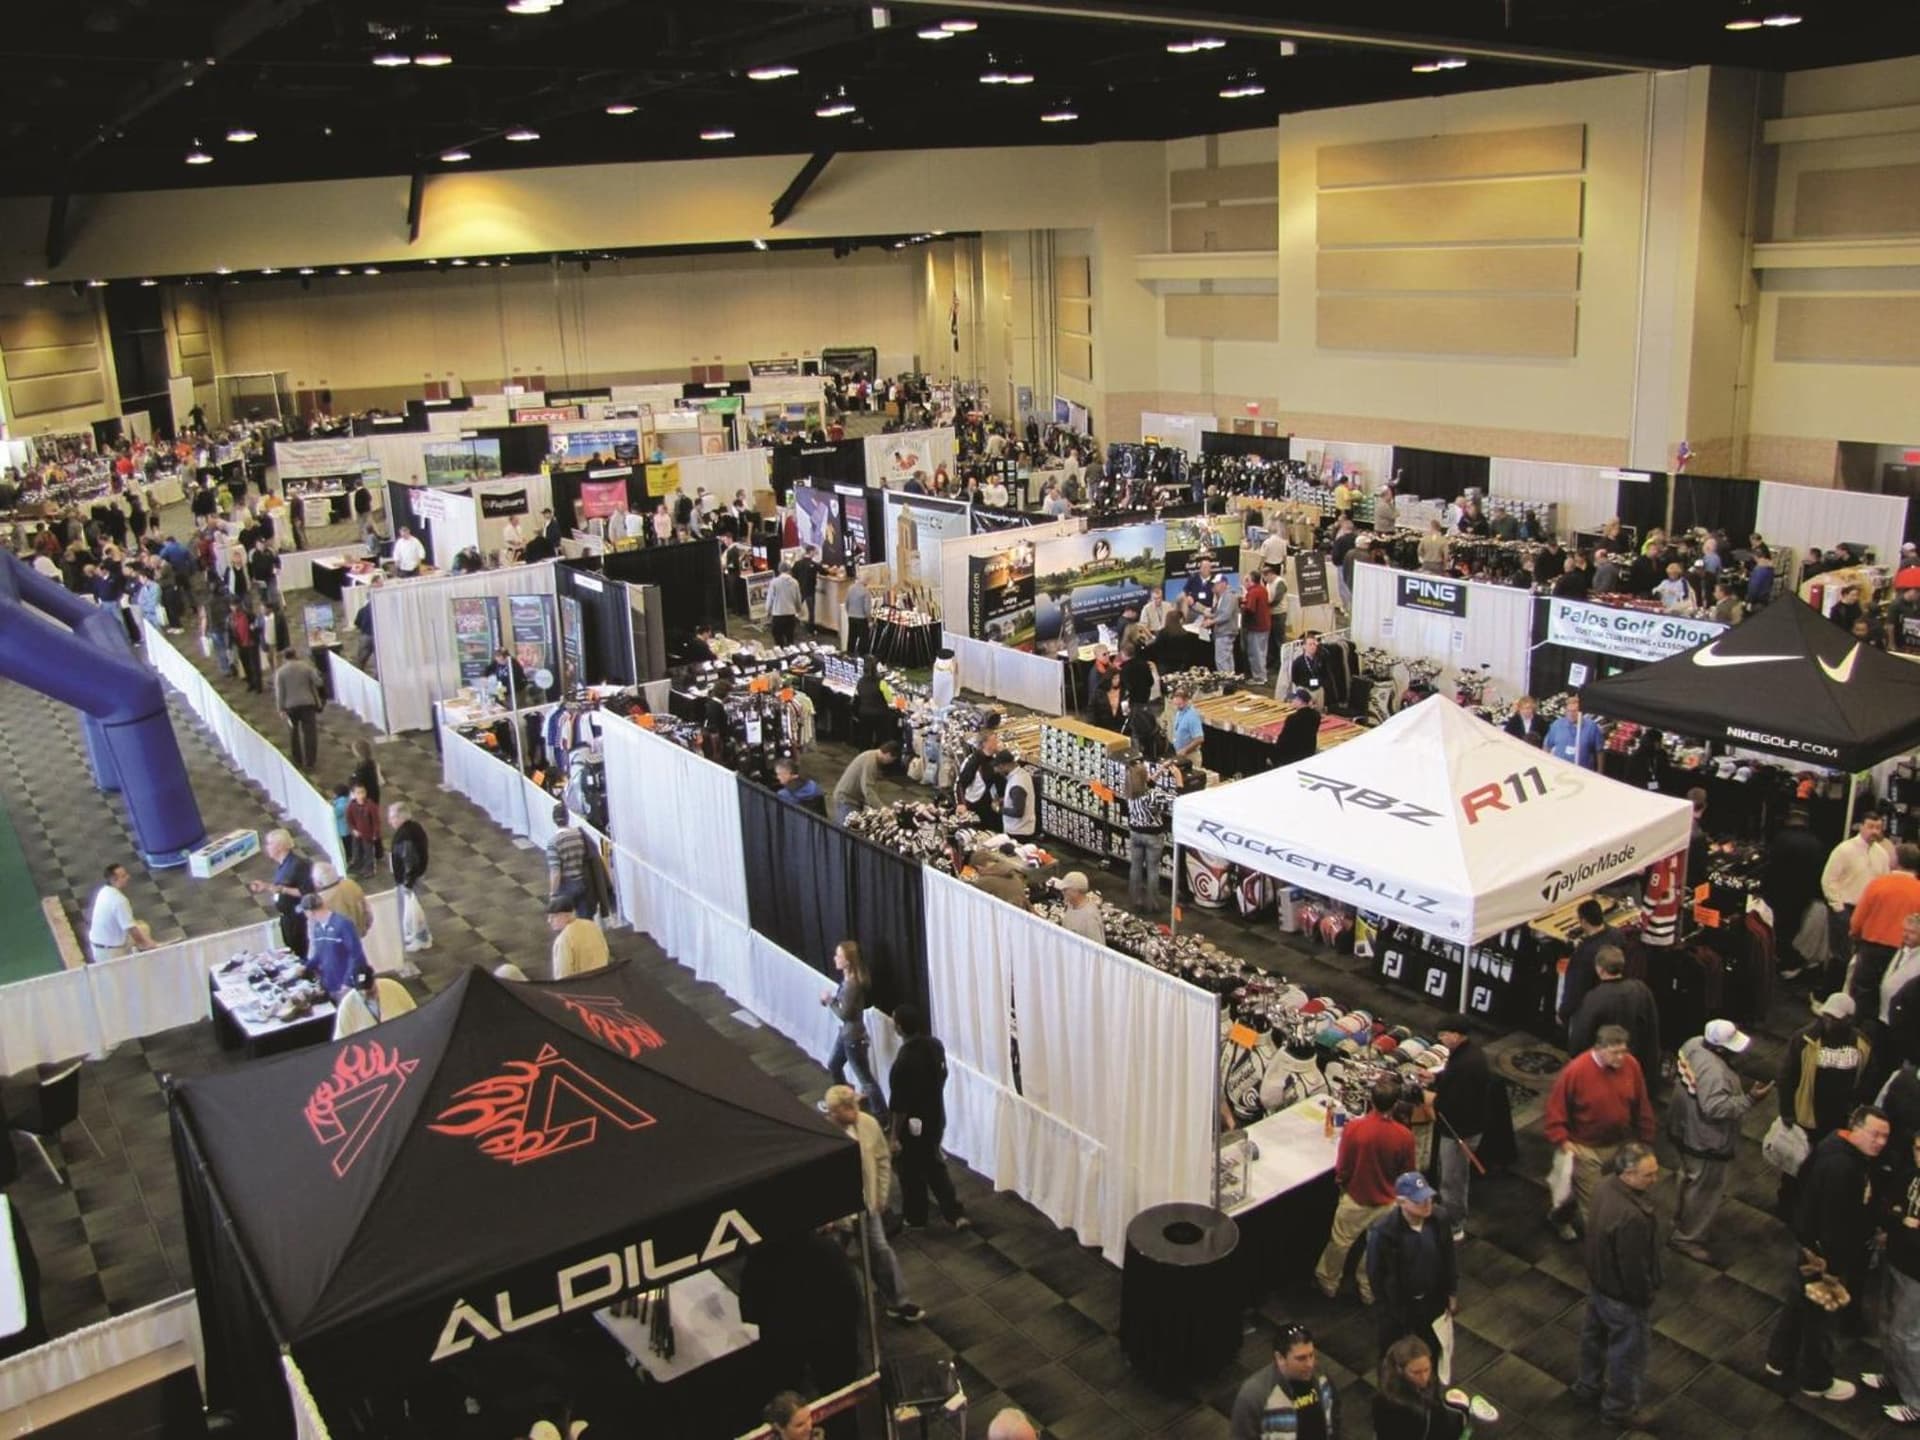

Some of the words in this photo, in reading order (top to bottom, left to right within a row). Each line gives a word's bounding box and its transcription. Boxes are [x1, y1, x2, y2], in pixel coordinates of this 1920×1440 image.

[1405, 579, 1457, 602] PING
[1560, 606, 1609, 629] Palos
[1614, 616, 1657, 636] Golf
[1661, 622, 1711, 644] Shop
[1623, 636, 1651, 647] FITTING
[1726, 726, 1838, 758] NIKEGOLF.COM
[1297, 770, 1444, 826] RBZ
[1541, 844, 1635, 903] TaylorMade
[429, 1209, 762, 1362] ALDILA
